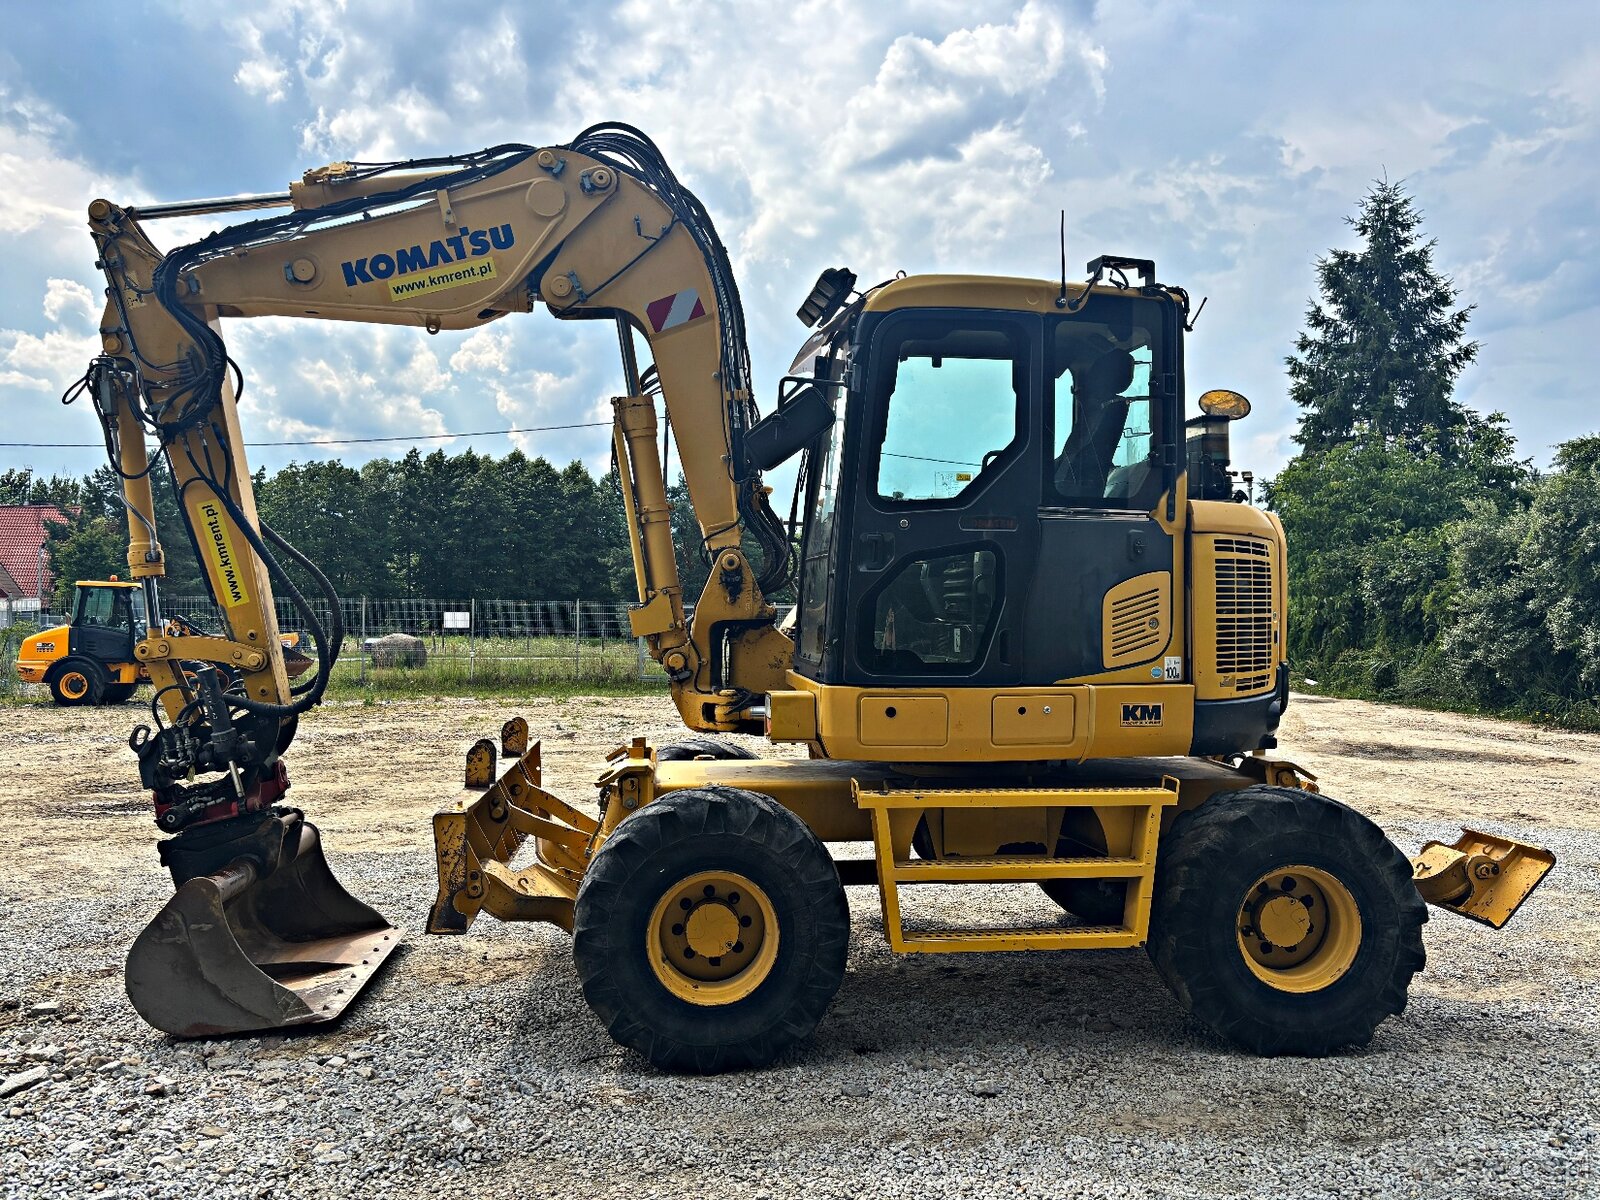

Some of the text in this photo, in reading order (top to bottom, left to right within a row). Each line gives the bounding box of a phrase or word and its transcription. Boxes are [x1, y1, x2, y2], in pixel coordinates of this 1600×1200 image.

[341, 223, 515, 287] KOMATSU
[392, 262, 493, 295] www.kmrent.pl
[202, 504, 242, 602] www.kmrent.pl
[1122, 704, 1162, 721] KM
